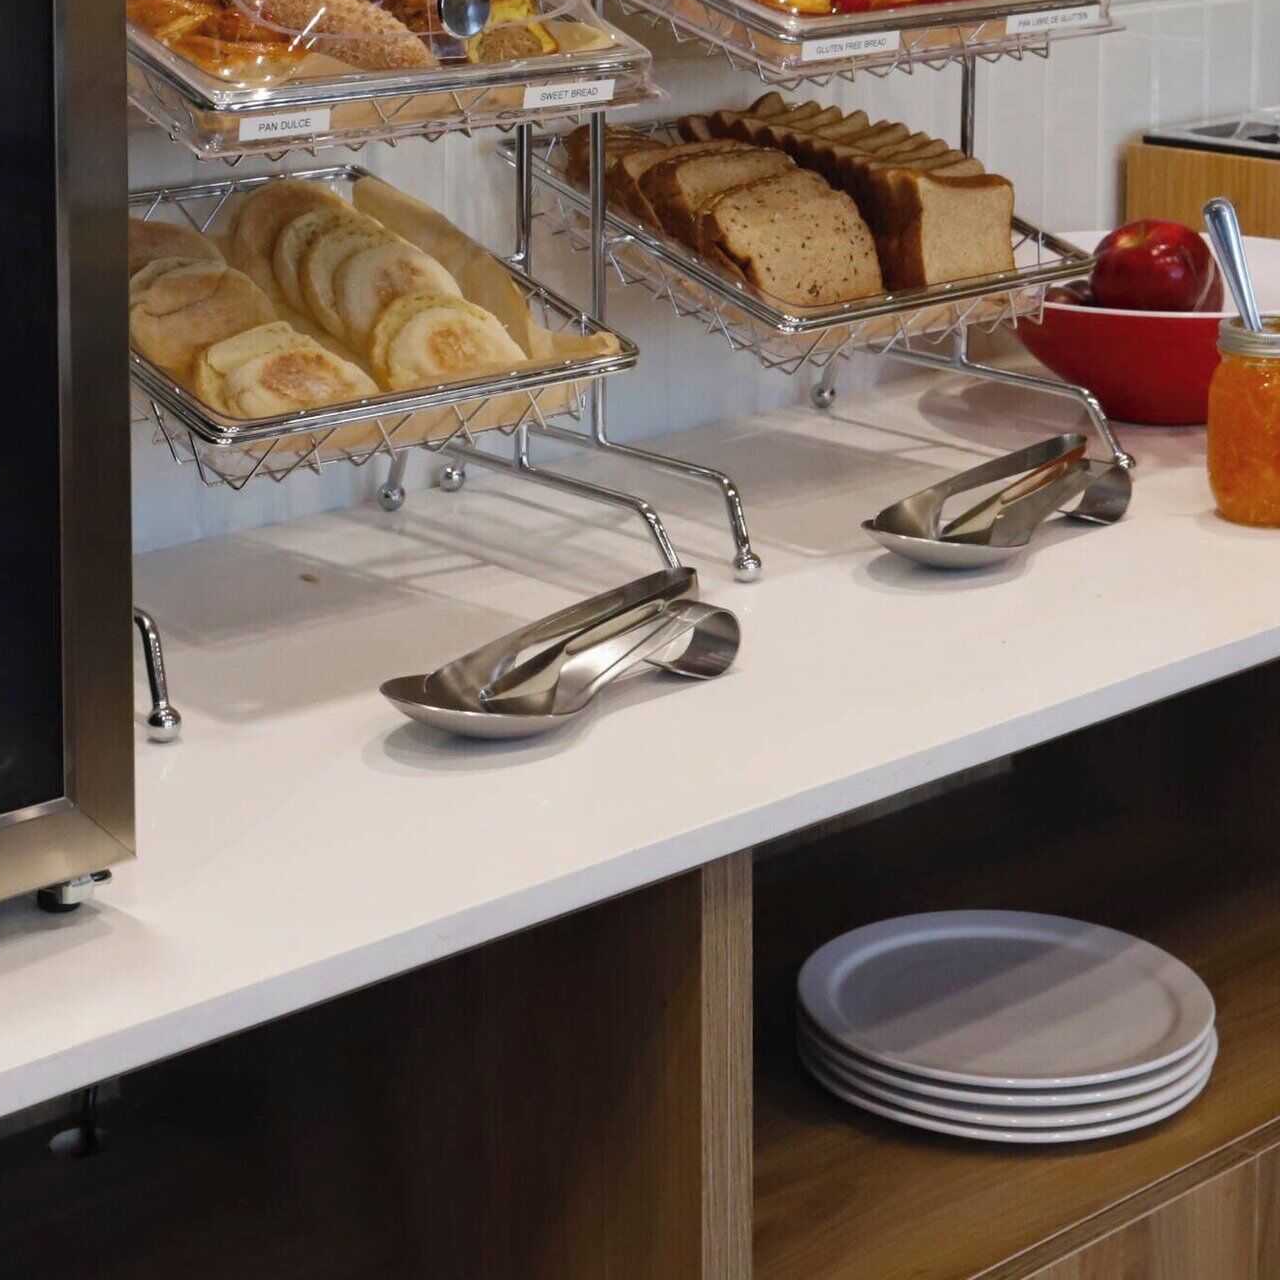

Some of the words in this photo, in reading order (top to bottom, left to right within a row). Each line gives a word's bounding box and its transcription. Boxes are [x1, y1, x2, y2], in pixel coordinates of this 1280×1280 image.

[816, 44, 843, 55] GLUTEN
[845, 40, 862, 50] FREE
[864, 38, 886, 48] BREAD
[540, 90, 568, 101] SWEET
[571, 87, 598, 98] BREAD
[259, 122, 278, 132] PAN
[280, 118, 311, 131] DULCE
